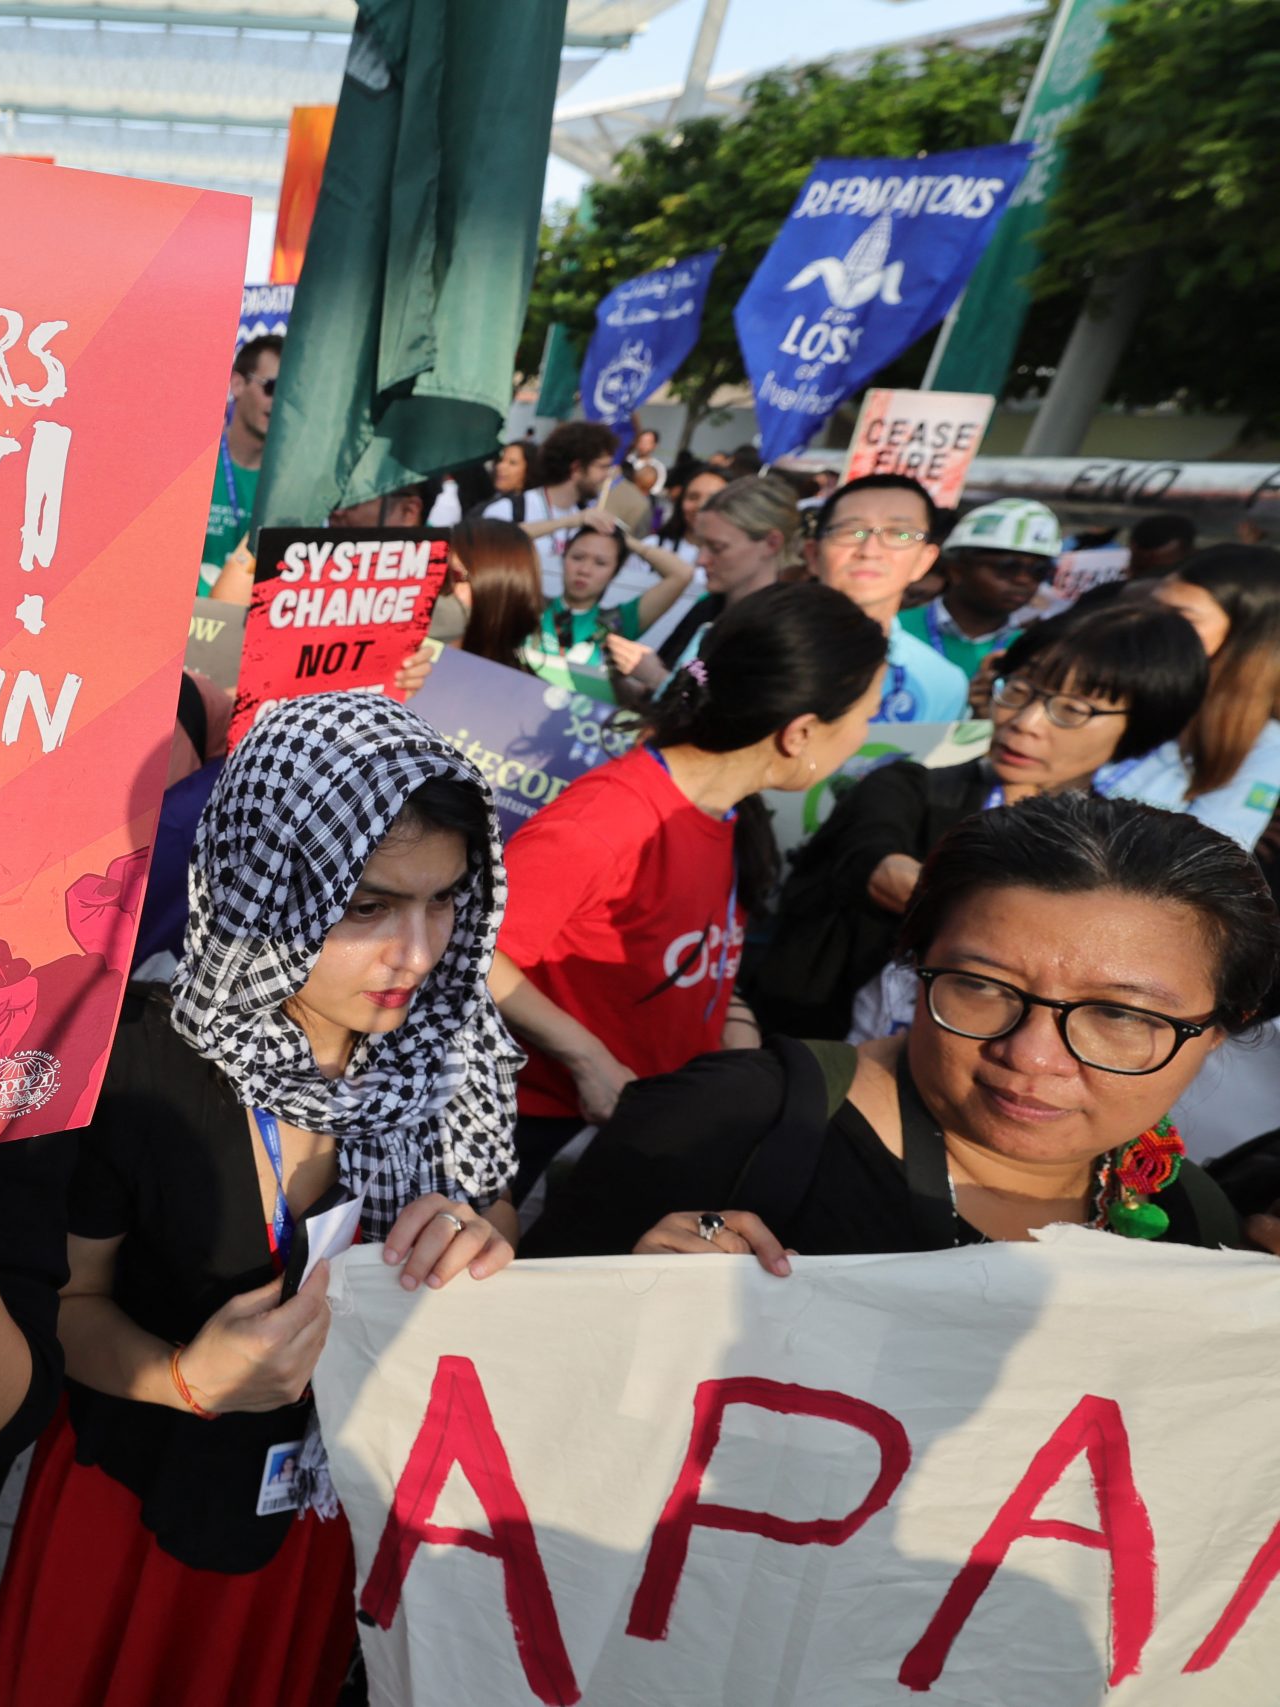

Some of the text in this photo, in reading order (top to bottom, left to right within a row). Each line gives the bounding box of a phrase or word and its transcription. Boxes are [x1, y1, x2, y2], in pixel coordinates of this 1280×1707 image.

[866, 419, 977, 449] CEASE
[280, 540, 432, 582] SYSTEM
[269, 585, 421, 629] CHANGE
[295, 640, 375, 679] NOT
[14, 1050, 54, 1061] CAMPAIGN
[52, 1059, 62, 1069] TO
[35, 1082, 61, 1110] JUSTICE
